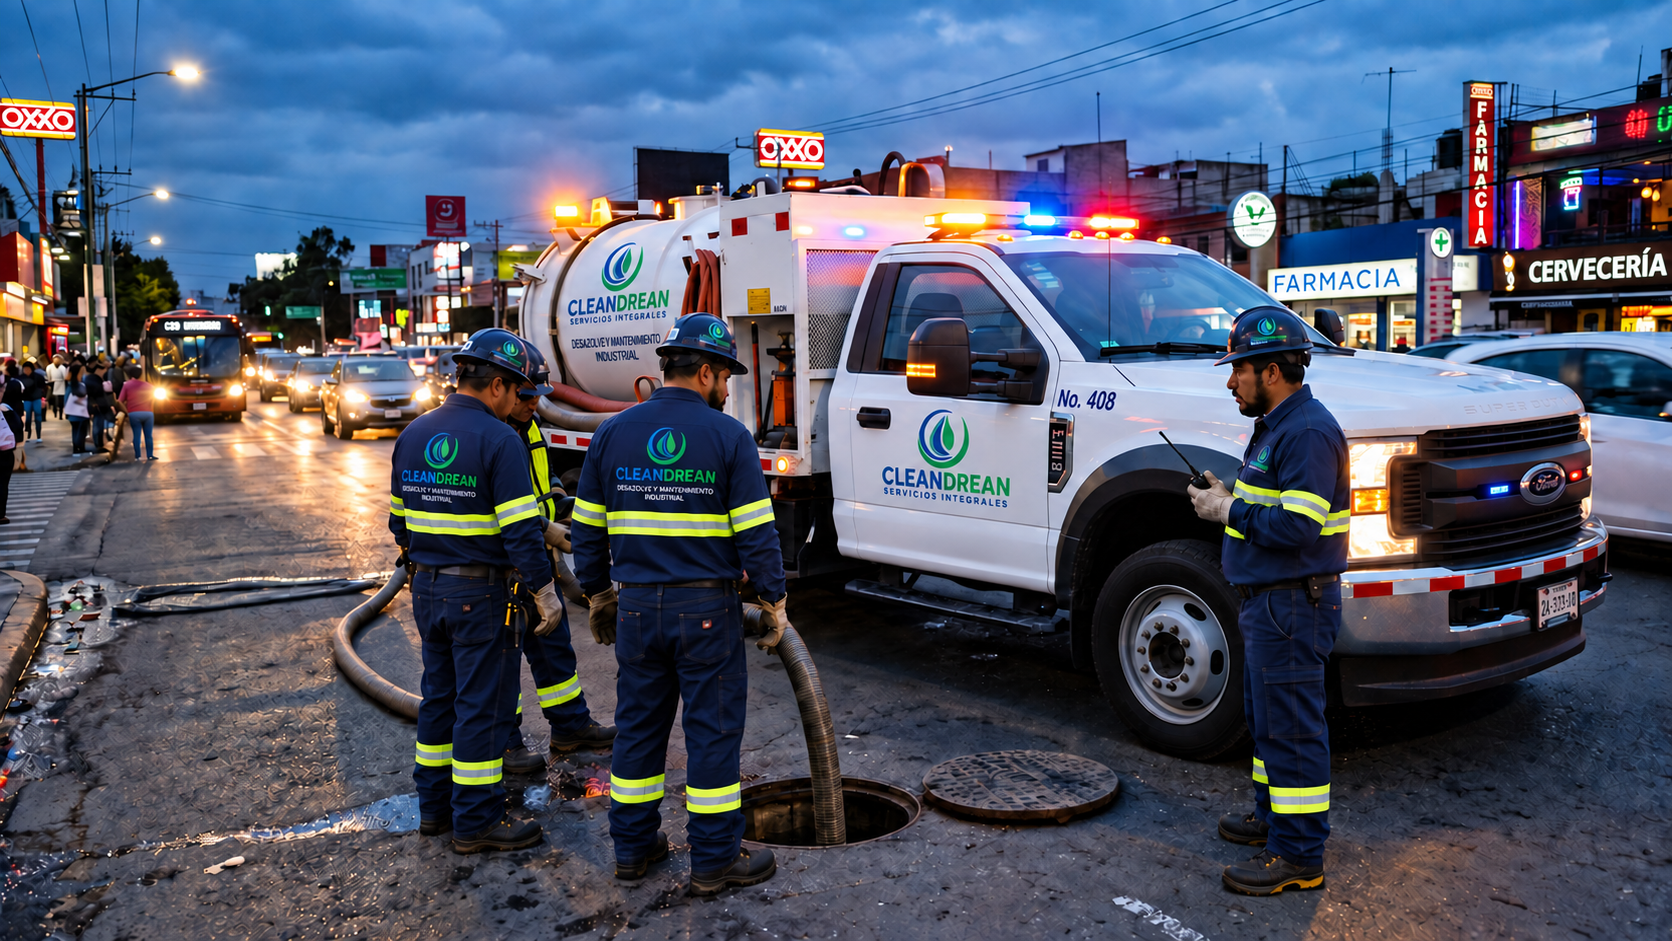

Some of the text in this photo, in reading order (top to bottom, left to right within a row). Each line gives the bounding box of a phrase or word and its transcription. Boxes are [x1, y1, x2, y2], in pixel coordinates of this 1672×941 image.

[2, 107, 74, 131] OXXO
[760, 136, 824, 161] OXXO
[1473, 101, 1488, 244] FARMACIA
[1528, 247, 1667, 283] CERVECERÍA
[1273, 268, 1400, 293] FARMACIA
[567, 289, 670, 316] CLEANDREAN
[569, 310, 667, 325] SERVICIOS INTEGRALES
[1057, 389, 1117, 411] No. 408
[1463, 401, 1527, 415] SUPER
[401, 469, 477, 488] CLEANDREAN
[616, 467, 716, 484] CLEANDREAN
[882, 466, 1011, 497] CLEANDREAN
[1535, 474, 1559, 491] Ford
[883, 487, 1008, 508] SERVICIOS INTEGRALES
